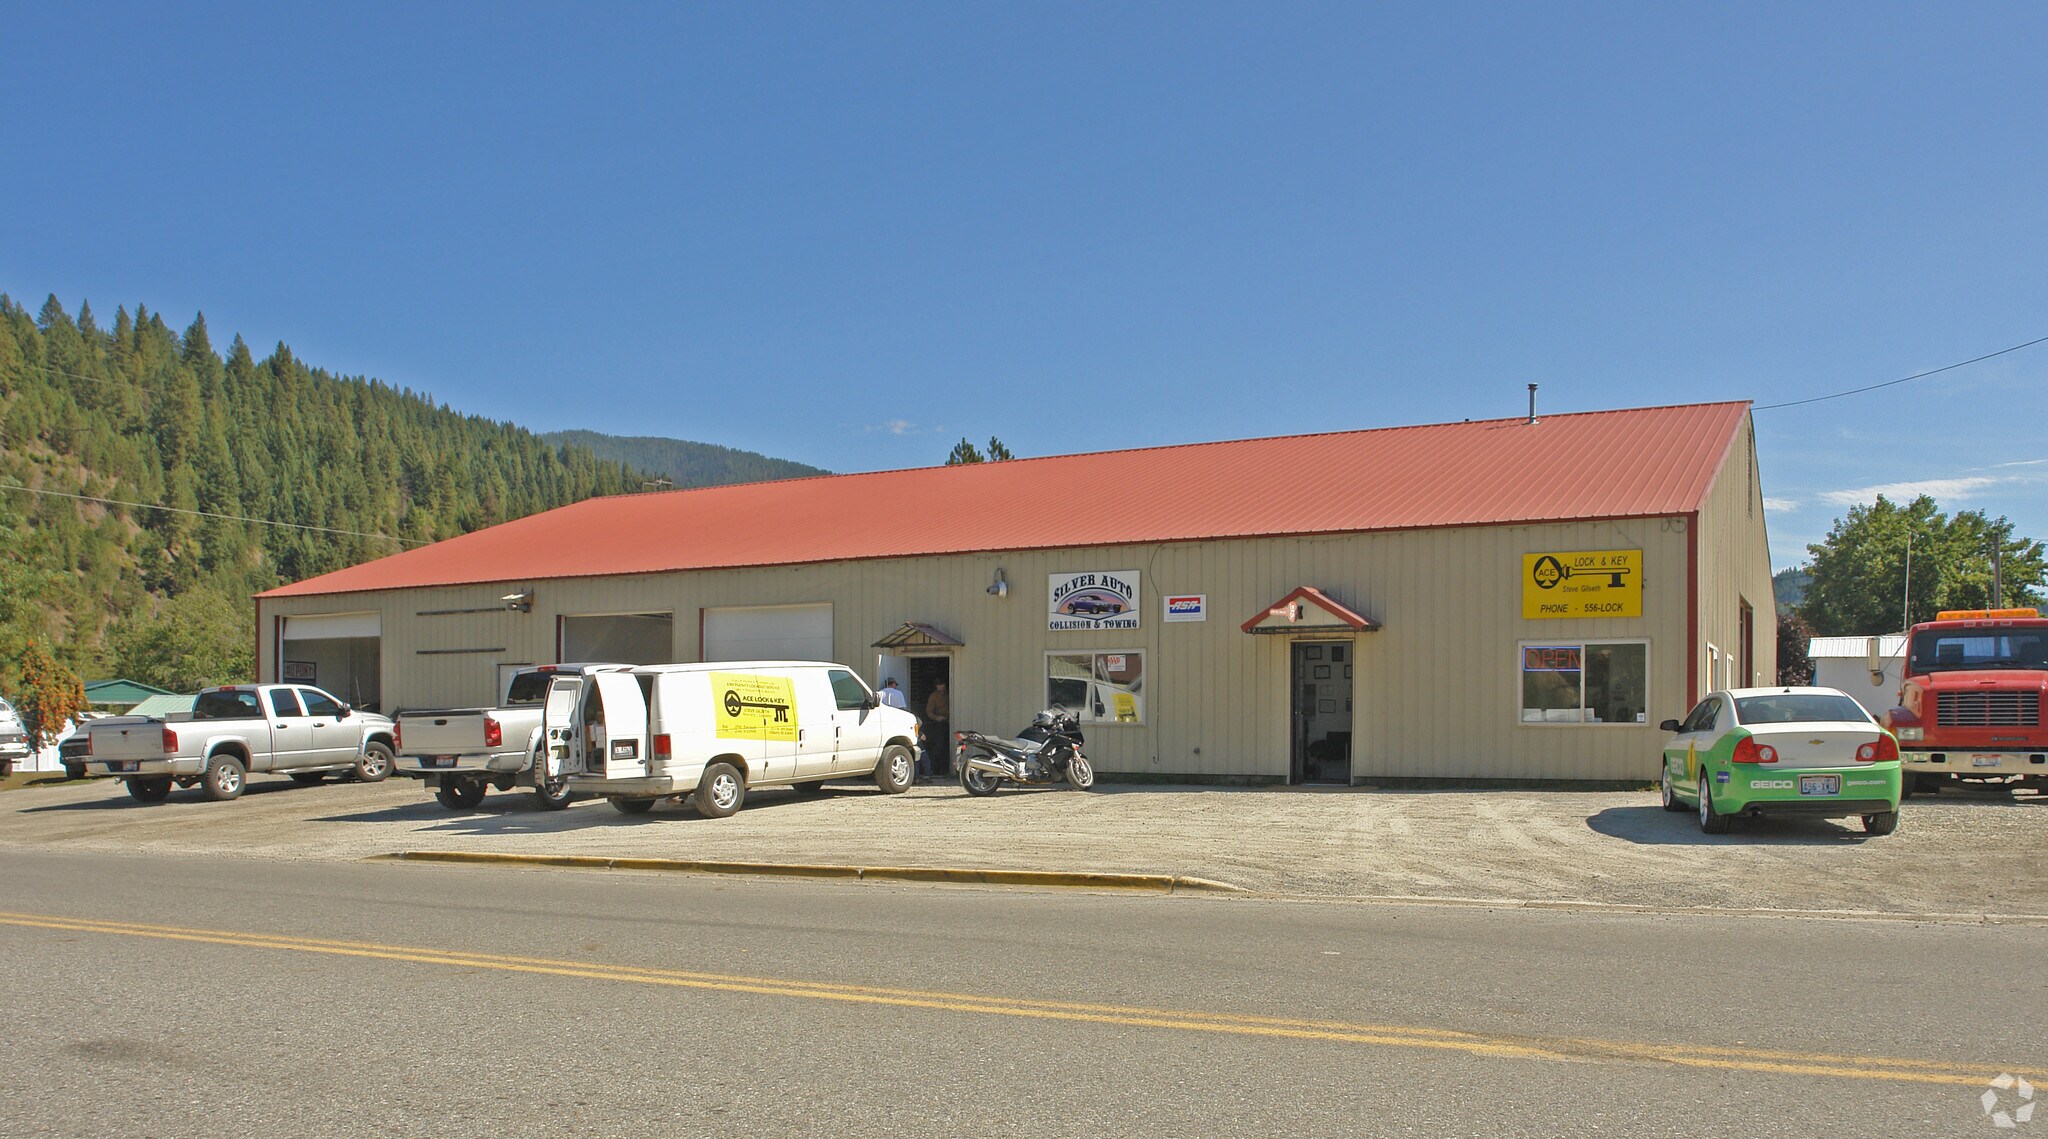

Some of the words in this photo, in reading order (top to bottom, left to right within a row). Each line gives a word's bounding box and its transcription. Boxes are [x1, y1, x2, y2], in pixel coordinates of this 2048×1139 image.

[1574, 557, 1595, 567] LOCK
[1600, 557, 1606, 566] &
[1611, 556, 1628, 566] KEY
[1538, 569, 1556, 577] ACE
[1054, 574, 1095, 602] SILVER
[1101, 575, 1132, 599] AUTO
[1540, 604, 1568, 613] PHONE
[1584, 603, 1624, 613] 556-LOCK
[1050, 620, 1091, 630] COLLISION
[1094, 619, 1100, 629] &
[1103, 619, 1137, 629] TOWING
[1525, 649, 1581, 668] OPEN
[1751, 781, 1793, 789] GEICO
